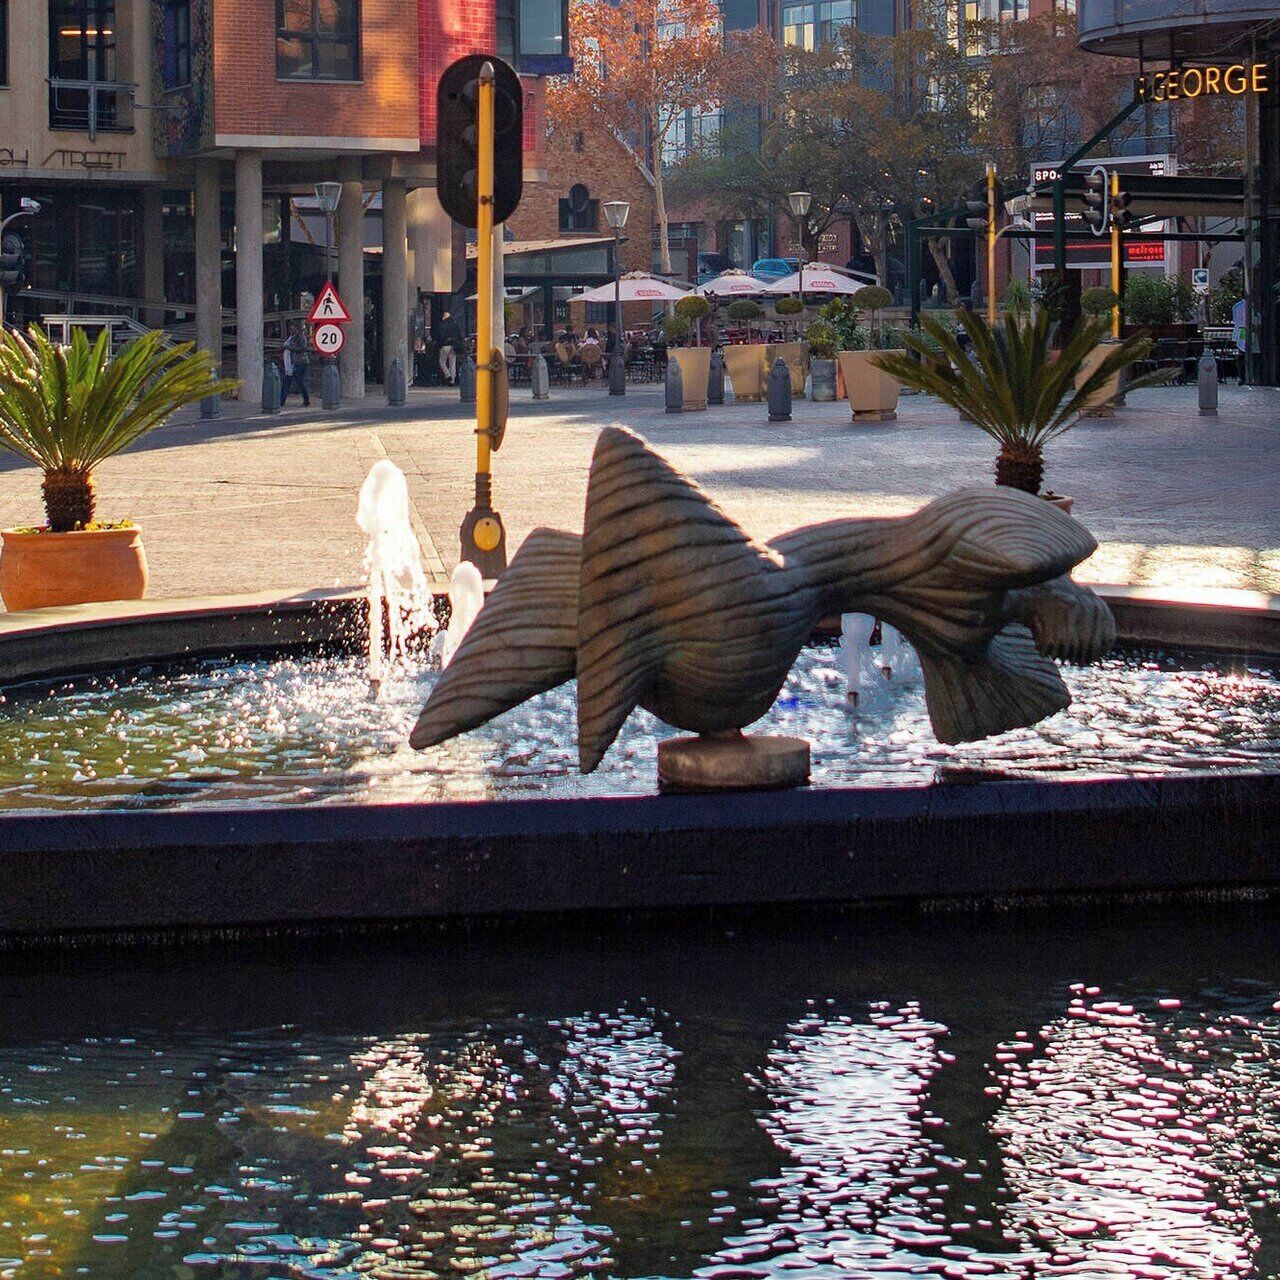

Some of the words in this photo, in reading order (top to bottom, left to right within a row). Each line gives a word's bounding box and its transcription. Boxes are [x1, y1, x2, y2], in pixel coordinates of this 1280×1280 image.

[1153, 63, 1269, 101] GEORGE
[1035, 170, 1062, 181] SPO
[321, 332, 337, 345] 20
